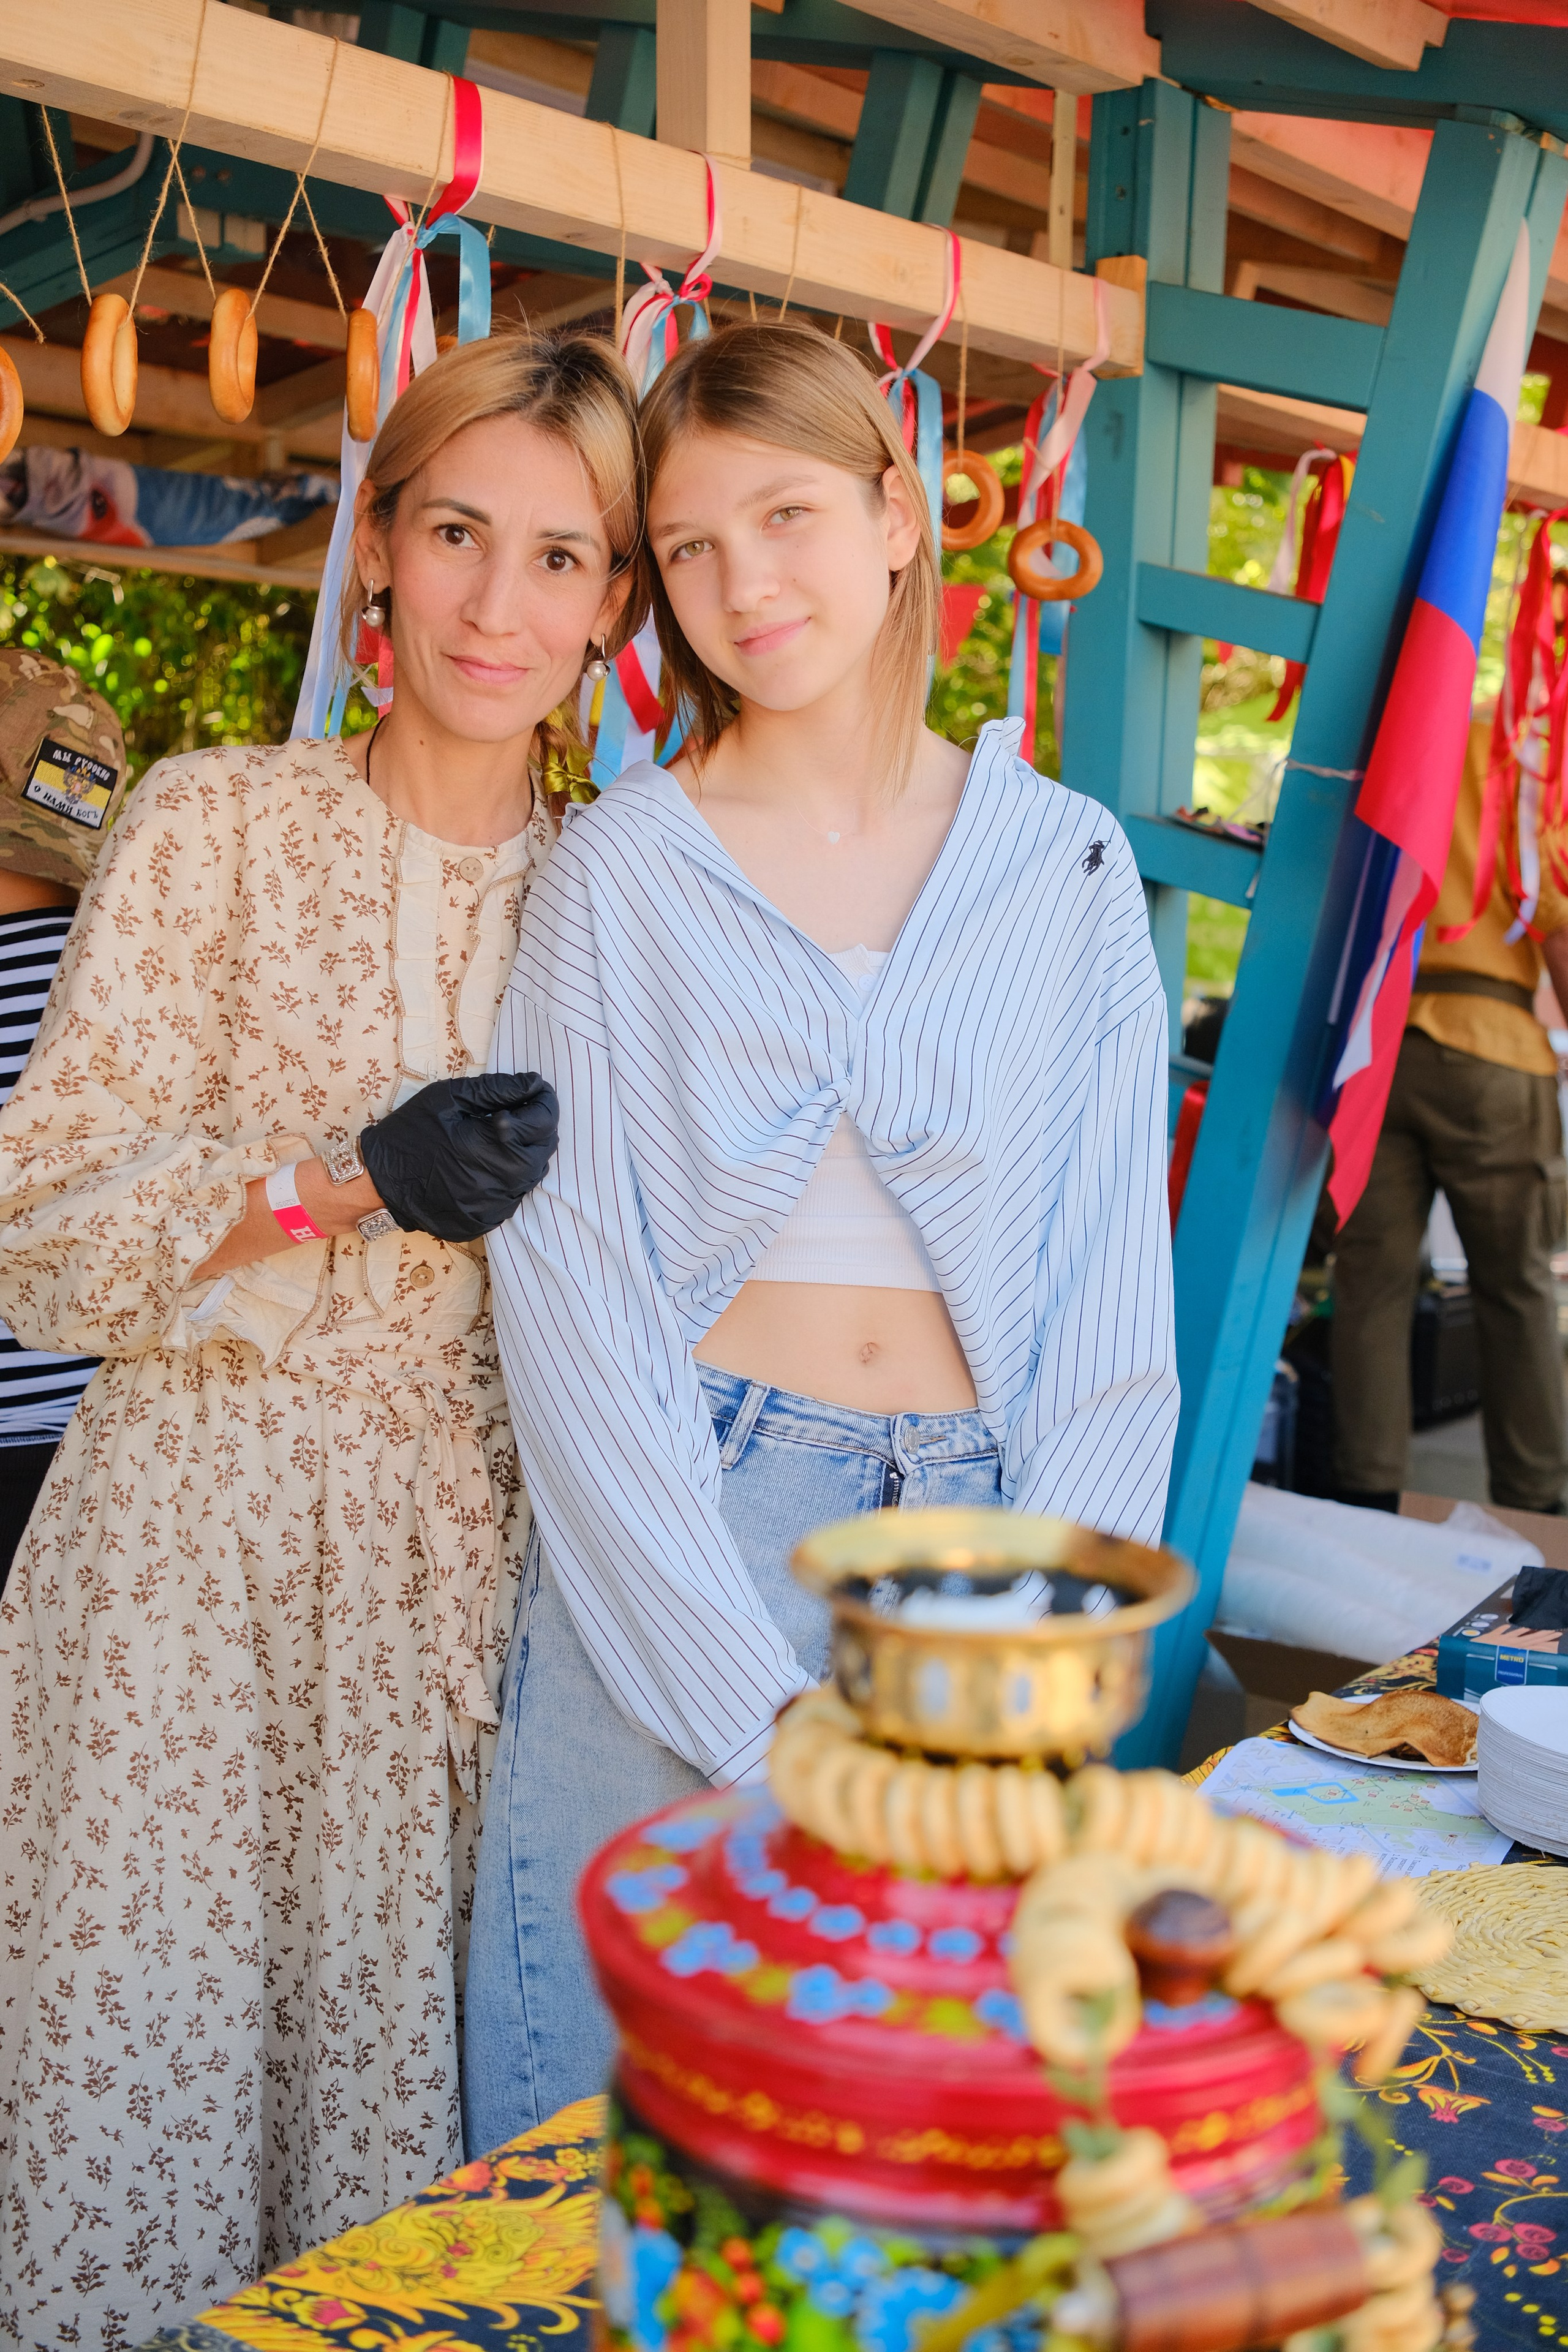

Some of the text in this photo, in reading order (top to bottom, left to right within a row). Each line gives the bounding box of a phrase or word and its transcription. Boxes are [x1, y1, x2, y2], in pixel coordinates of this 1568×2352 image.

[53, 749, 72, 763] МЫ
[43, 792, 74, 816] НАМИ
[1499, 1654, 1525, 1663] METRO
